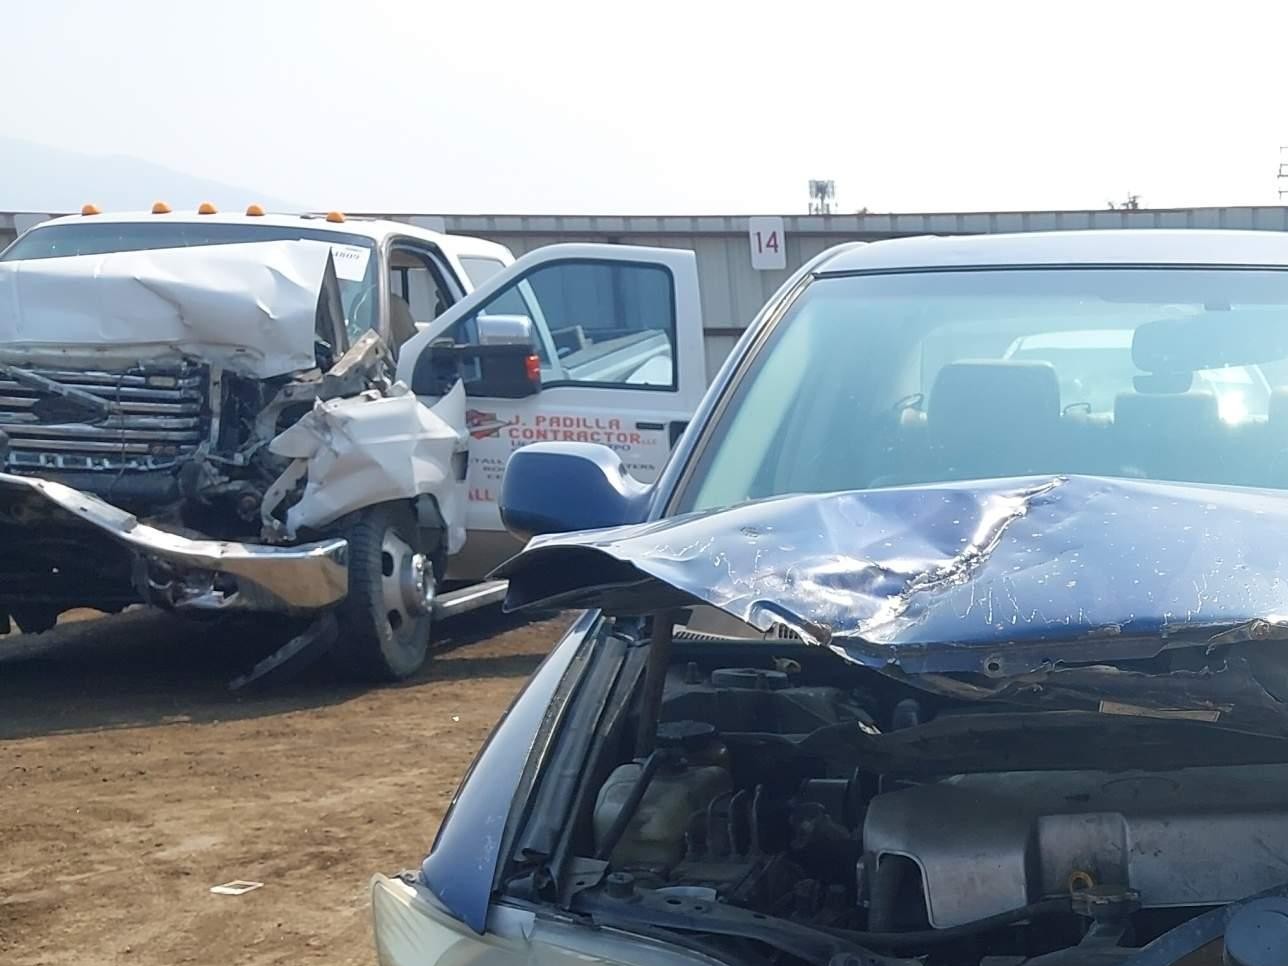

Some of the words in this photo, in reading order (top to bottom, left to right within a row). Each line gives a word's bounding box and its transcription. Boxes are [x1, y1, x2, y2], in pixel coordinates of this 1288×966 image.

[756, 231, 779, 253] 14
[510, 415, 526, 426] J.
[535, 415, 621, 431] PADILLA
[509, 428, 641, 445] CONTRACTOR
